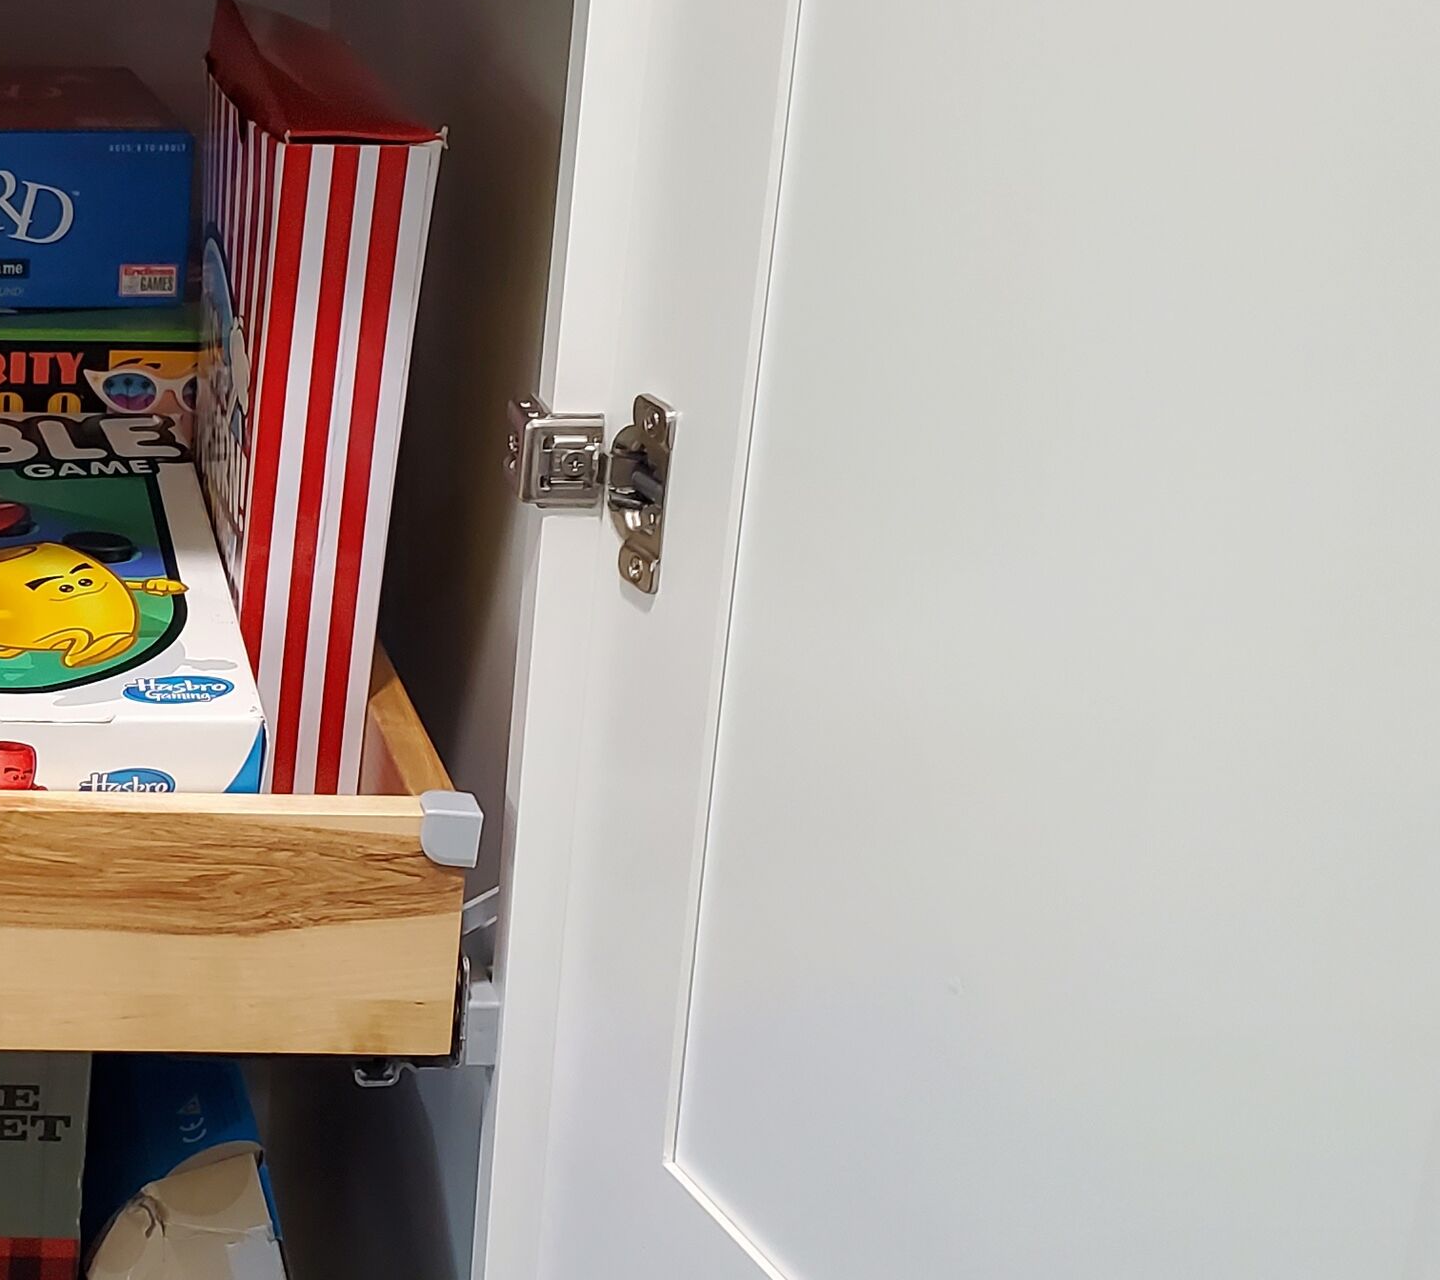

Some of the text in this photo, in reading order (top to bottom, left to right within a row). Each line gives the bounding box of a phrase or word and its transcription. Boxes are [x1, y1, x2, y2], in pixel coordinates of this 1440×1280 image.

[140, 276, 173, 292] GAMES
[22, 460, 152, 479] GAME
[125, 677, 227, 693] Hasbro
[145, 690, 210, 702] Gaming
[79, 773, 170, 793] Hasbro
